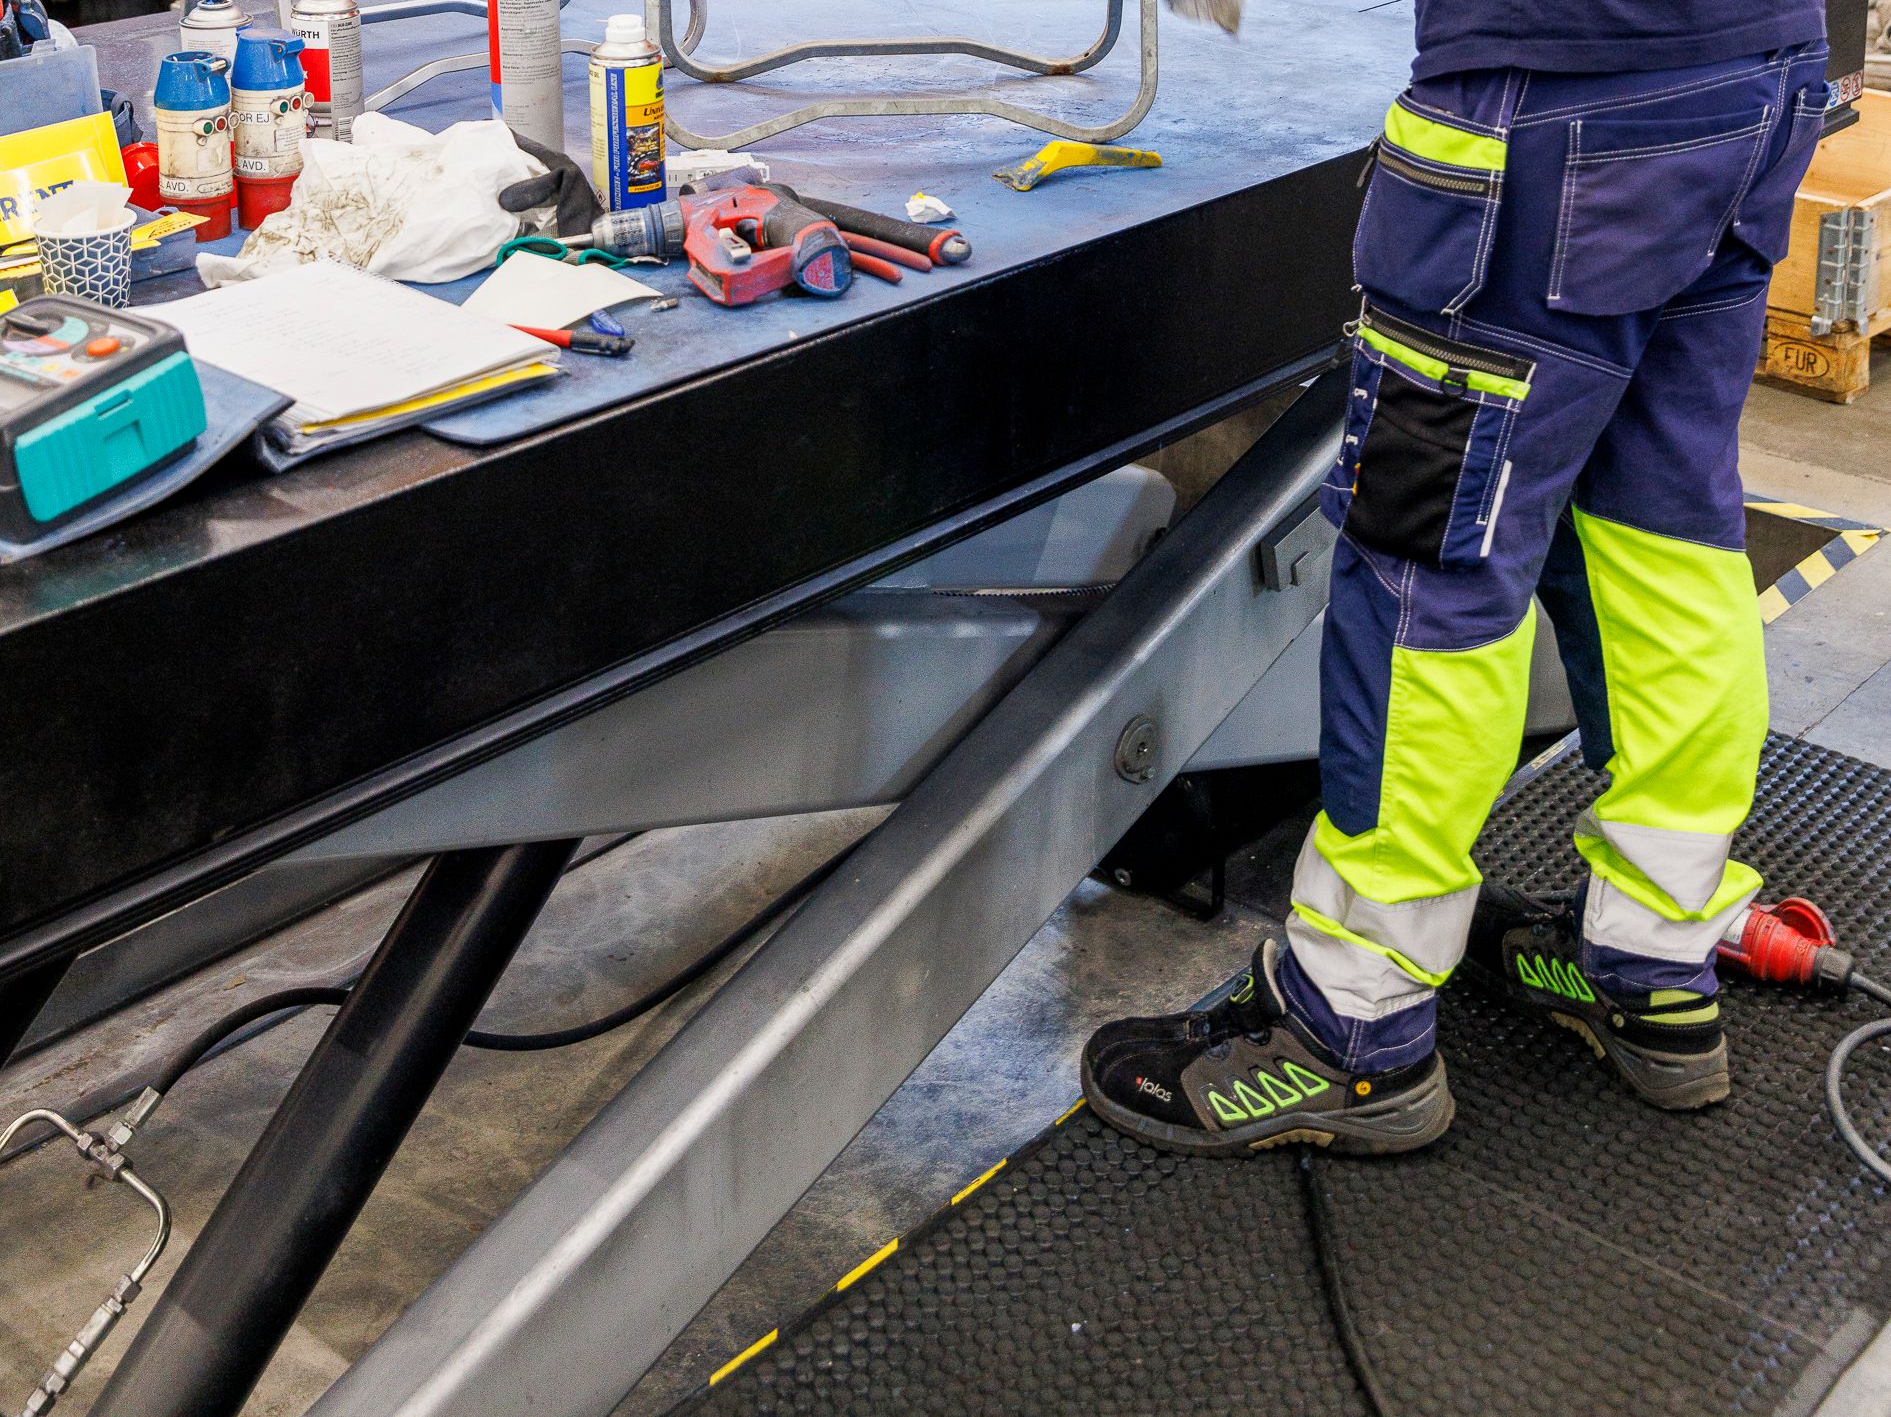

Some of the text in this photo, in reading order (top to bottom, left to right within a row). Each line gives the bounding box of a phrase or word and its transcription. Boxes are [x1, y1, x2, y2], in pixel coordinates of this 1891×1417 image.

[256, 113, 270, 123] EJ
[242, 160, 266, 171] AVD.
[166, 181, 189, 192] AVD.
